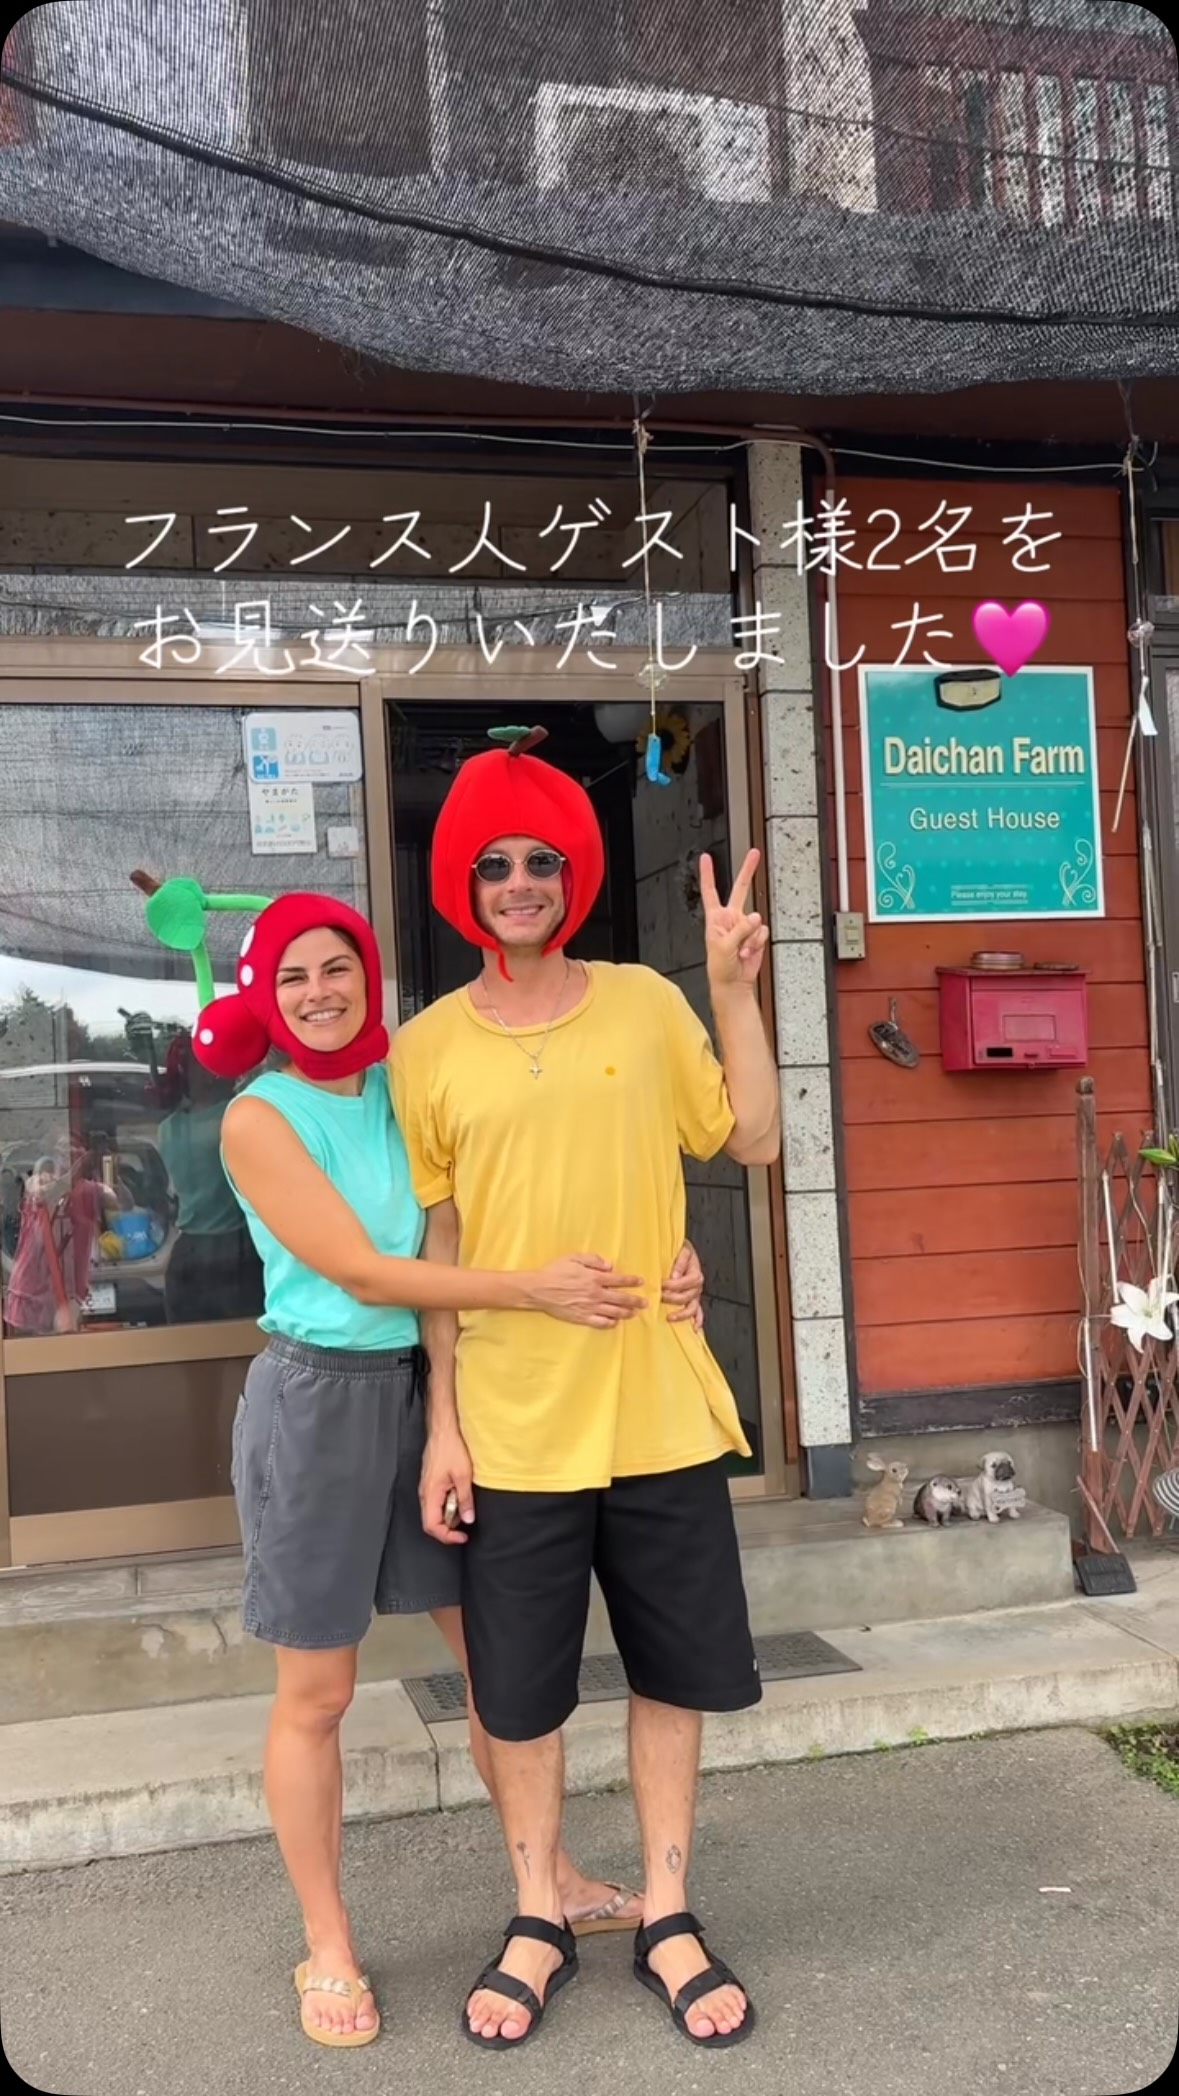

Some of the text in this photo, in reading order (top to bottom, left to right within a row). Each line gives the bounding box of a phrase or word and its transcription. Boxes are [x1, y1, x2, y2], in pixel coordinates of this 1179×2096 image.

[884, 736, 1085, 776] Daichan Farm
[909, 807, 1060, 830] Guest House
